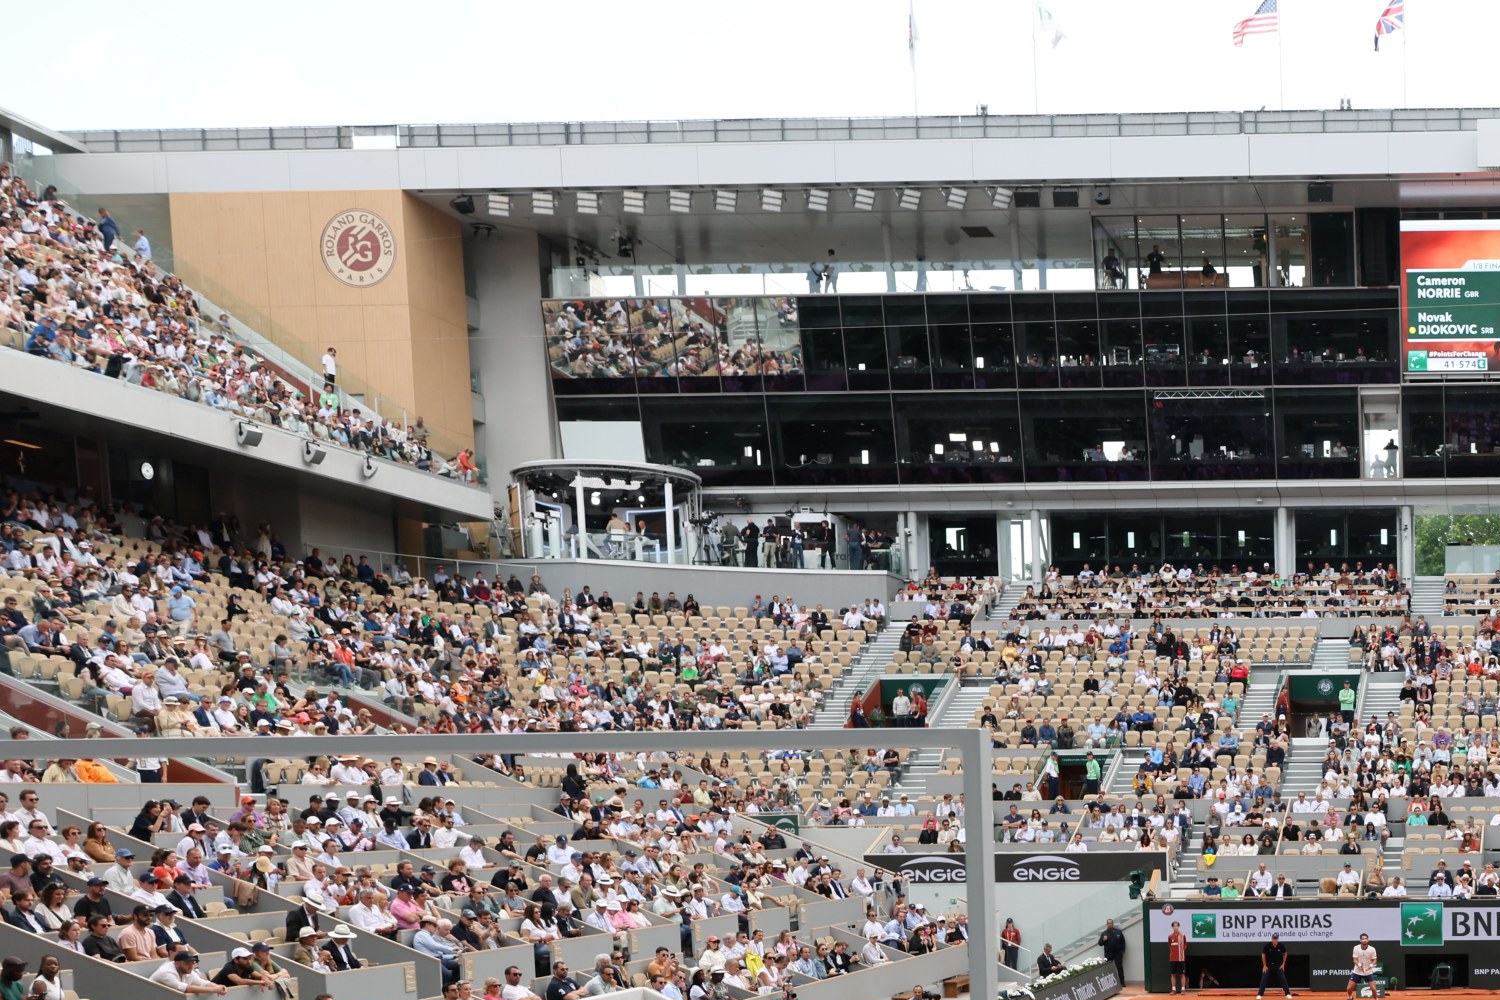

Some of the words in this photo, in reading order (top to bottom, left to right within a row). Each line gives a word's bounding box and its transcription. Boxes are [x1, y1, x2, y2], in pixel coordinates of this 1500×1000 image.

[325, 213, 355, 257] ROLAND
[359, 213, 392, 256] GARROS
[337, 266, 384, 283] PARIS
[1417, 275, 1466, 286] Cameron
[1417, 288, 1461, 298] NORRIE
[1418, 312, 1452, 322] Novak
[1418, 324, 1478, 335] DJOKOVIC
[1222, 915, 1257, 929] BNP
[1262, 914, 1333, 929] PARIBAS
[1231, 931, 1255, 939] banque
[1298, 930, 1308, 938] qui
[1309, 930, 1333, 938] change
[1095, 973, 1118, 992] Emirates
